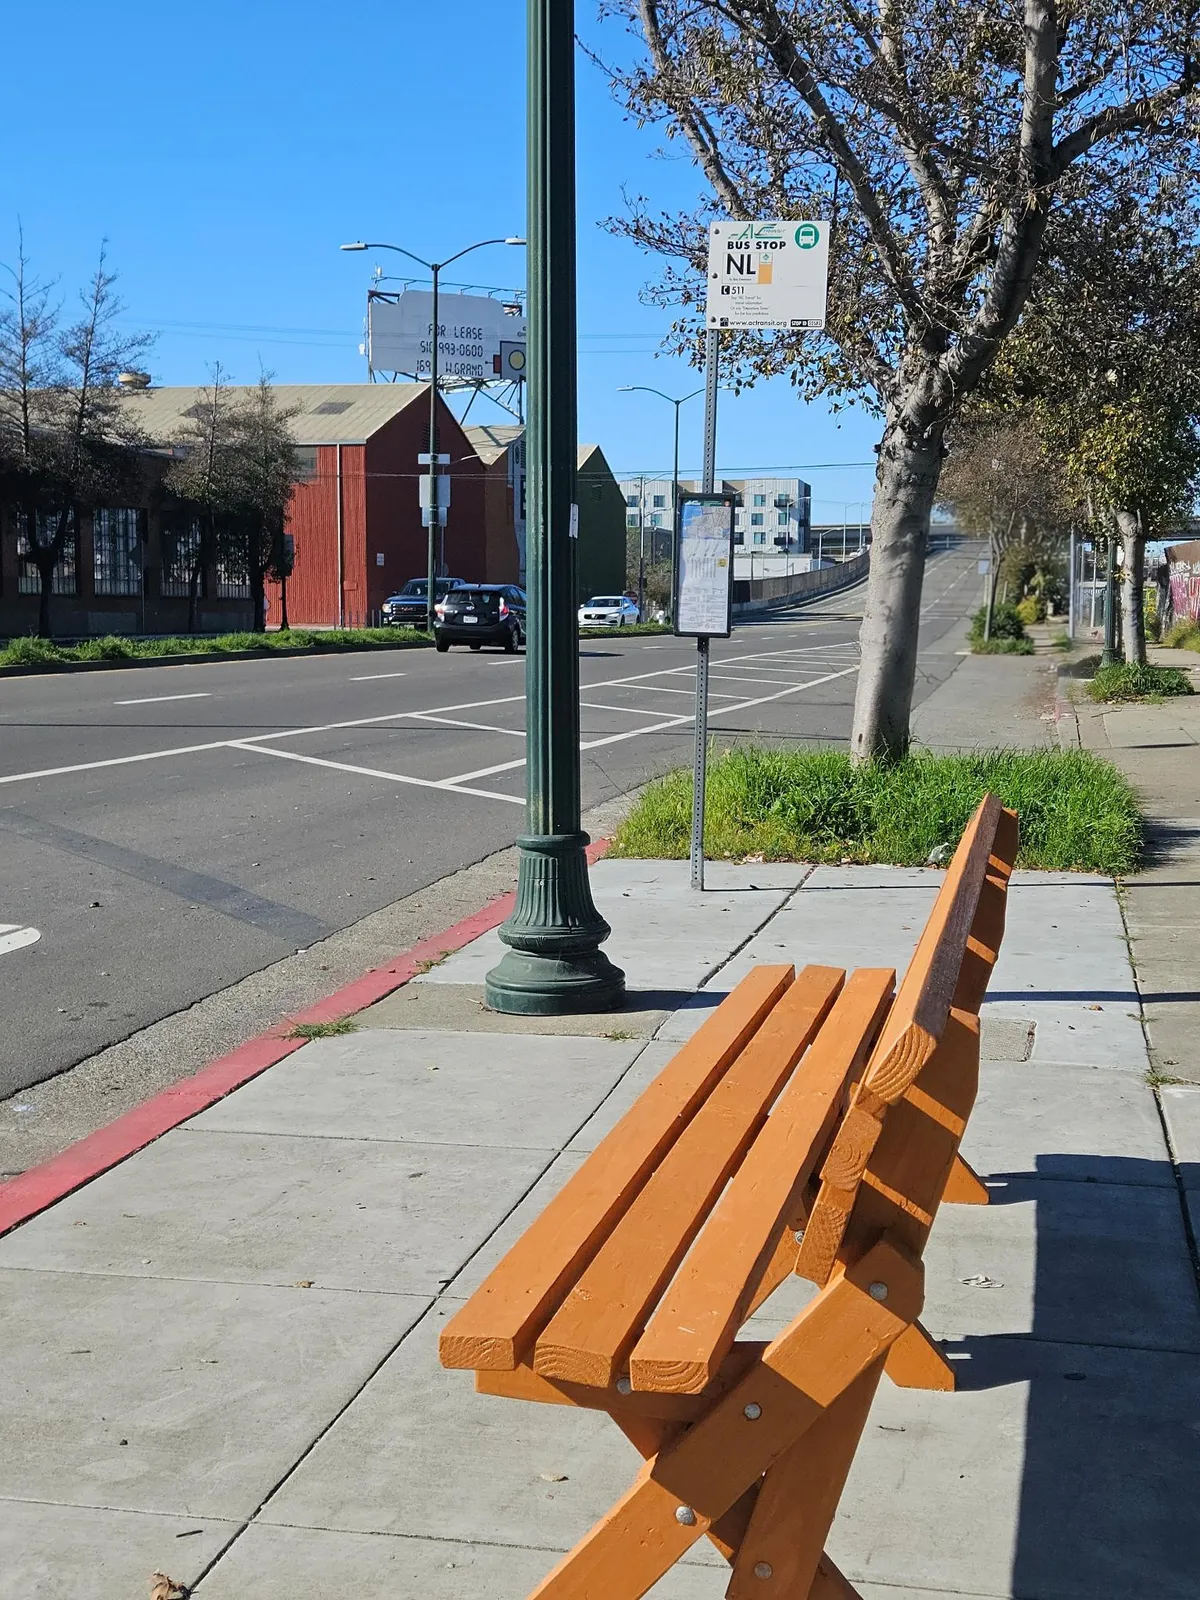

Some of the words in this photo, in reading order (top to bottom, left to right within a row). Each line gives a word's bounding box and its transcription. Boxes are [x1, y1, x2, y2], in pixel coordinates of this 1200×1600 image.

[727, 241, 750, 249] BUS
[756, 241, 786, 249] STOP
[726, 254, 756, 275] NL
[731, 286, 744, 295] 511
[454, 326, 483, 340] LEASE
